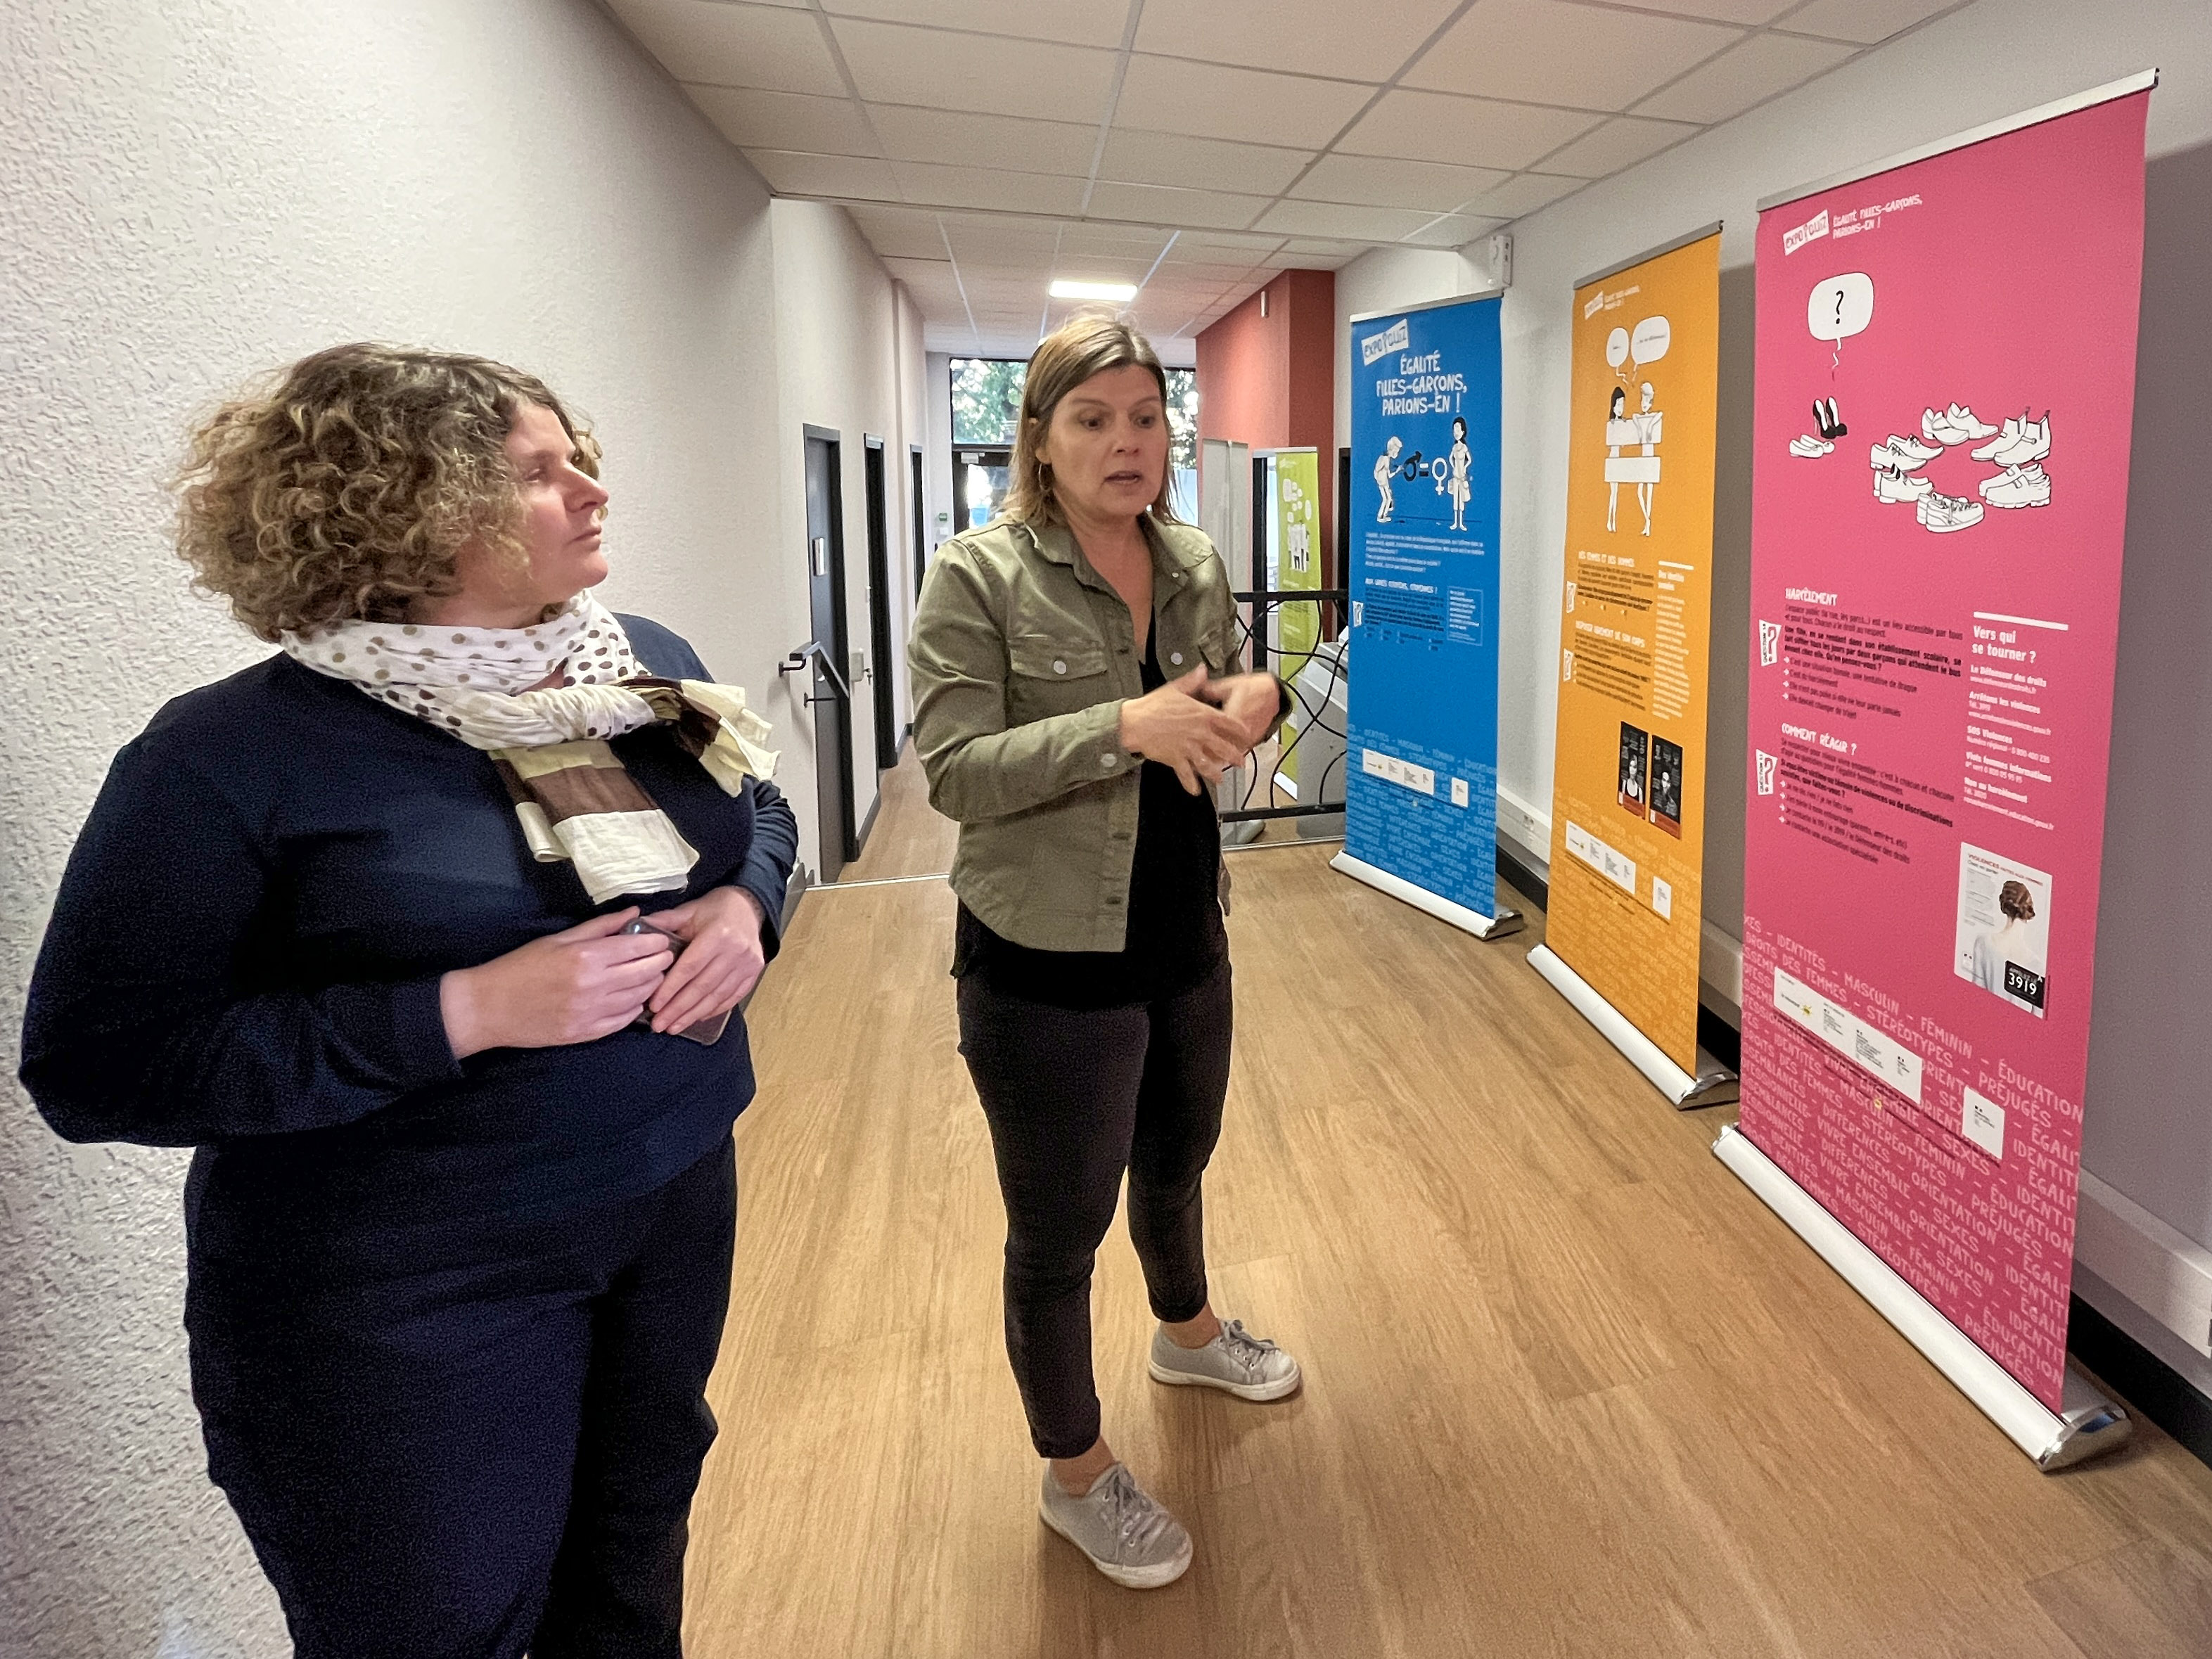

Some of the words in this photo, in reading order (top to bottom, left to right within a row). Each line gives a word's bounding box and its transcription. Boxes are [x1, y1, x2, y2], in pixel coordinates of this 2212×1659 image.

[1833, 209, 1857, 227] ÉGALITÉ
[1860, 194, 1922, 219] FILLES-GARÇONS,
[1833, 222, 1874, 239] PARLONS-EN
[1877, 216, 1881, 229] !
[1836, 290, 1843, 324] ?
[1400, 350, 1440, 375] ÉGALITÉ
[1376, 373, 1468, 397] FILLES-GARÇONS,
[1382, 397, 1450, 416] PARLONS-EN
[1456, 393, 1460, 414] !
[1785, 587, 1837, 606] HARCÈLEMENT
[1971, 643, 1983, 655] se
[1987, 642, 2026, 662] tourner
[2028, 650, 2036, 664] ?
[1973, 624, 1996, 641] Vers
[1999, 627, 2016, 646] qui
[1781, 722, 1817, 743] COMMENT
[1820, 733, 1848, 753] RÉAGIR
[1851, 743, 1857, 756] ?
[2008, 972, 2037, 995] 3919
[1746, 931, 1777, 959] DROITS
[1782, 954, 1801, 973] DES
[1806, 967, 1847, 1002] FEMMES
[1867, 1005, 1953, 1068] STÉRÉOTYPES
[1979, 1072, 2052, 1128] PRÉJUGÉS
[1777, 935, 1825, 971] IDENTITÉS
[1844, 973, 1898, 1014] MASCULIN
[1921, 1016, 1972, 1058] FÉMININ
[1998, 1058, 2083, 1124] ÉDUCATION
[1743, 1025, 1775, 1057] DROITS
[1779, 1053, 1798, 1075] DES
[1803, 1070, 1843, 1109] FEMMES
[1862, 1115, 1946, 1186] STÉRÉOTYPES
[1971, 1195, 2042, 1258] PRÉJUGÉS
[1775, 1034, 1822, 1075] IDENTITÉS
[1915, 1134, 1964, 1179] FÉMININ
[1990, 1184, 2073, 1259] ÉDUCATION
[1942, 1133, 1990, 1176] SEXES
[1817, 1115, 1846, 1148] VIVRE
[1852, 1143, 1910, 1200] ENSEMBLE
[1933, 1207, 1979, 1253] SEXES
[1823, 1103, 1890, 1163] DIFFÉRENCES
[1911, 1172, 1996, 1245] ORIENTATION
[1820, 1152, 1848, 1186] VIVRE
[1855, 1182, 1913, 1241] ENSEMBLE
[1936, 1250, 1983, 1298] SEXES
[1822, 1137, 1888, 1200] DIFFÉRENCES
[1909, 1209, 1993, 1285] ORIENTATION
[1799, 1170, 1839, 1213] FEMMES
[1857, 1222, 1941, 1302] STÉRÉOTYPES
[1964, 1315, 2034, 1385] PRÉJUGÉS
[1836, 1185, 1888, 1237] MASCULIN
[1909, 1246, 1958, 1298] FÉMININ
[1983, 1306, 2063, 1390] ÉDUCATION
